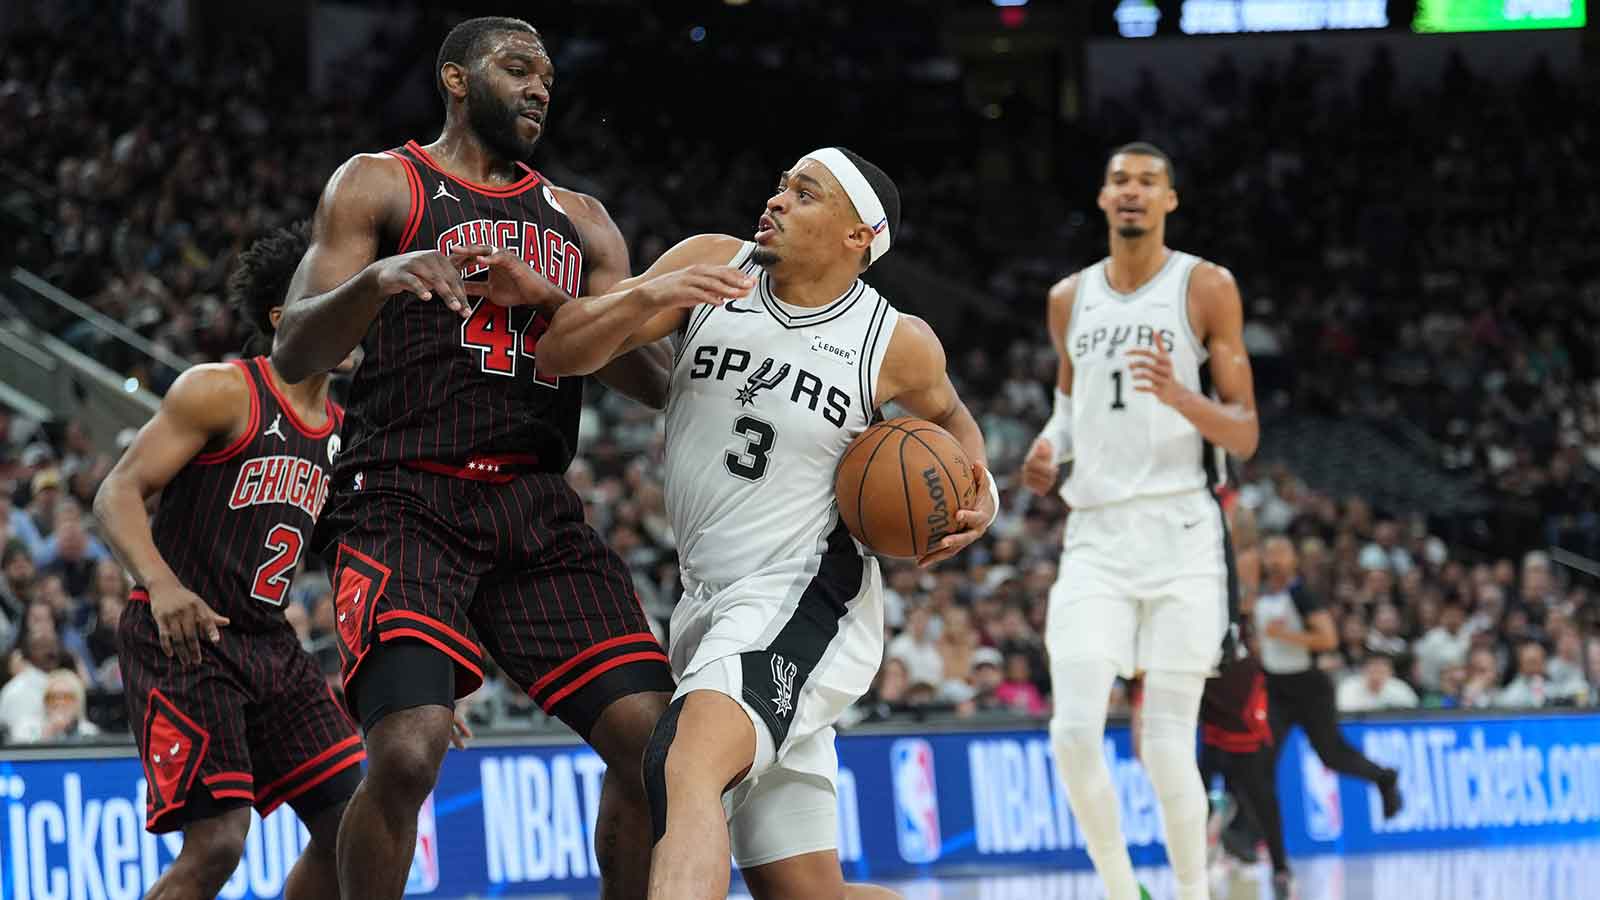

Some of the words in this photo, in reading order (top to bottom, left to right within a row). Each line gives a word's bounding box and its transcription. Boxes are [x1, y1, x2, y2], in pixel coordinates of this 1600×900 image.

[816, 340, 852, 361] LEDGER
[1076, 324, 1175, 359] SPURS
[690, 345, 851, 428] SPURS
[1110, 370, 1126, 410] 1
[723, 413, 777, 483] 3
[250, 523, 304, 606] 2
